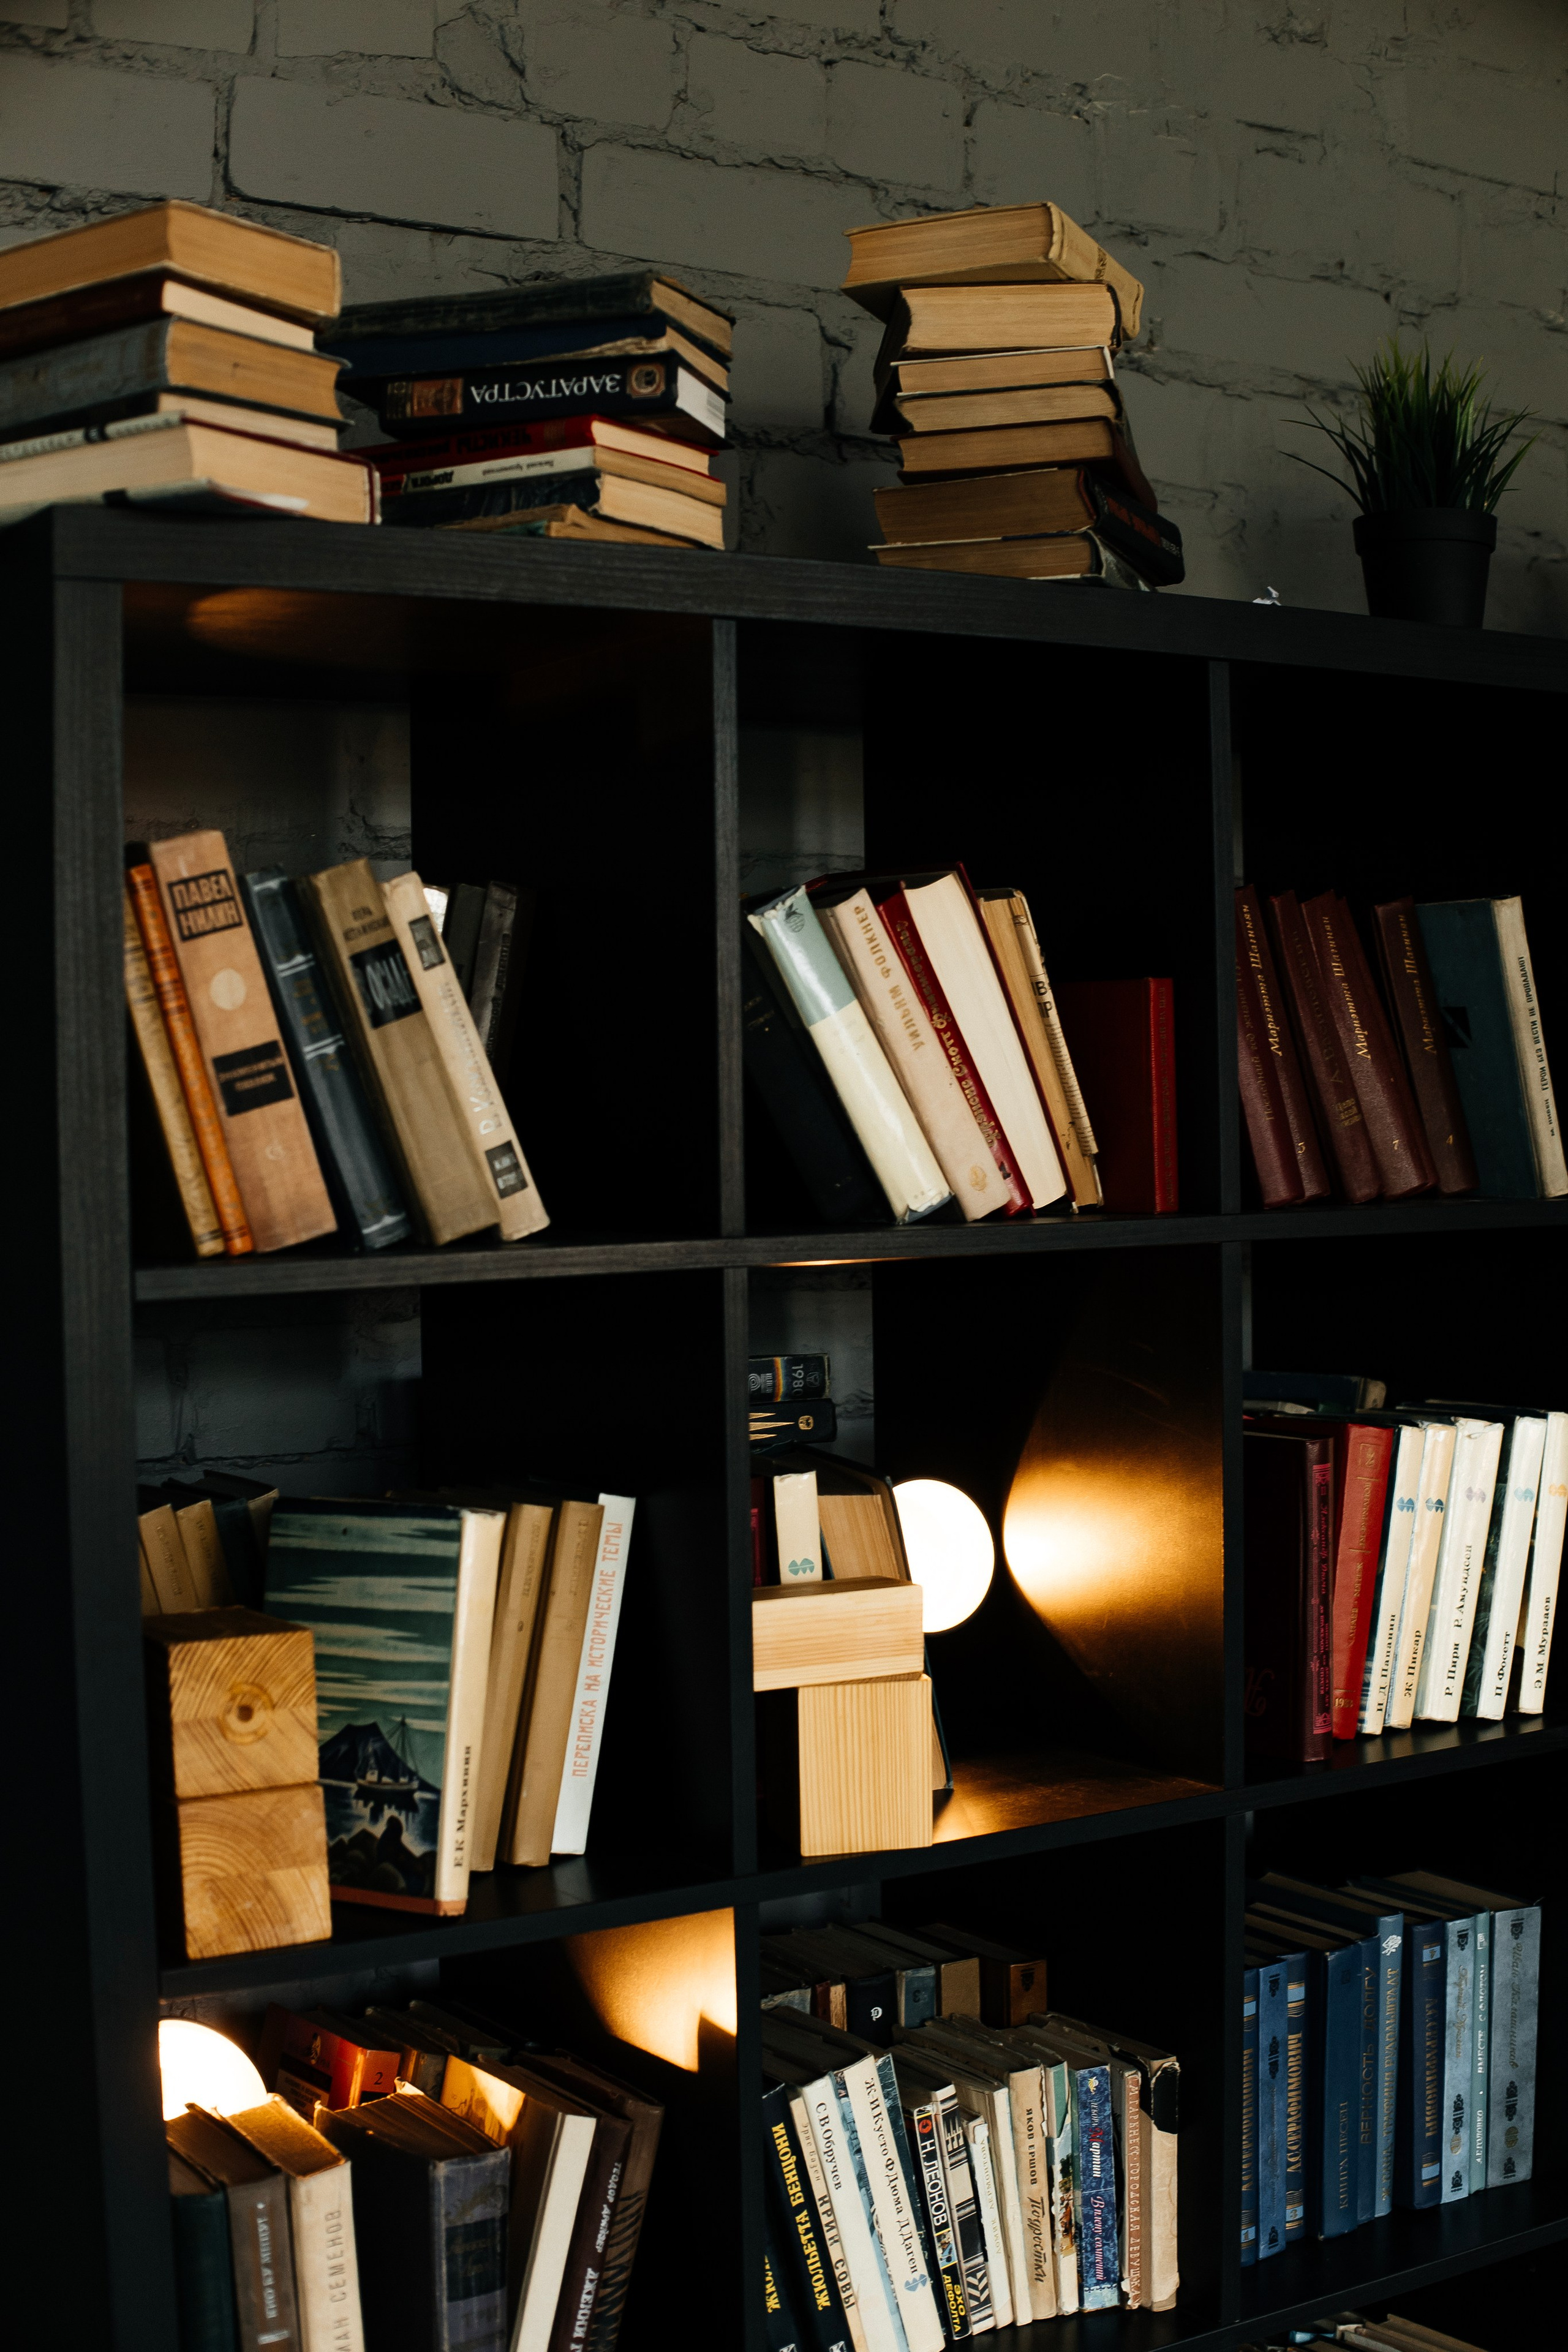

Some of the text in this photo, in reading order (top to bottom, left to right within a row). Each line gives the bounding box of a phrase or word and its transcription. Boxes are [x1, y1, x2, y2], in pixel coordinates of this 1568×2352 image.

[471, 374, 622, 404] ЗАРАТУСТРА
[174, 874, 232, 909] ПАВЕЛ
[178, 899, 238, 937] НИЛИН
[854, 906, 925, 1050] УИЛЬЯМ ФОЛКНЕР
[1242, 905, 1283, 1057] Мариэтта Шагинян
[1322, 917, 1371, 1061] Мариэтта Шагинян
[1398, 914, 1437, 1055] Мариэтта Шагинян
[1518, 956, 1534, 1003] ПРОПАДАЮТ
[1528, 1006, 1536, 1017] НЕ
[1530, 1020, 1542, 1045] ВЕСТИ
[941, 1031, 967, 1077] Скотт
[1536, 1048, 1545, 1063] БЕЗ
[1539, 1066, 1550, 1091] ГЕРОИ
[1297, 1142, 1306, 1154] 5
[1446, 1134, 1453, 1145] 4
[791, 1363, 804, 1396] 1980
[571, 1521, 623, 1777] ПЕРЕПИСКА НА ИСТОРИЧЕСКИЕ ТЕМЫ
[1381, 1614, 1396, 1678] Папанин
[1445, 1545, 1472, 1697] Р. Пири Р. Амундсен
[1538, 1596, 1551, 1657] Мурзаев
[1404, 1630, 1422, 1698] Ж. Пикар
[1498, 1631, 1510, 1681] Фосетт
[456, 1746, 472, 1831] Мархинин
[374, 2071, 383, 2085] 2
[1361, 1967, 1377, 2144] ВЕРНОСТЬ ДОЛГУ
[1383, 2071, 1395, 2136] ГРАФИНЯ
[809, 2151, 821, 2182] Базен
[979, 2139, 995, 2210] ЛЕРМОНТОВА
[1026, 2107, 1038, 2185] ЯКОВ ЕРШОВ
[1088, 2127, 1106, 2178] Мартин
[595, 2162, 622, 2253] ТЕОДОР ДРАЙЗЕР
[921, 2139, 948, 2227] Н. ЛЕОНОВ
[1129, 2162, 1140, 2232] ГОРОДСКАЯ
[1340, 2159, 1348, 2209] КНИГА
[772, 2122, 831, 2311] ЖЮЛЬЕТТА БЕНЦОНИ
[1027, 2196, 1047, 2283] Подростки
[1090, 2196, 1106, 2280] В плену сомнений
[325, 2210, 347, 2303] СЕМЕНОВ
[818, 2195, 856, 2310] КРИК СОВЫ
[1129, 2237, 1141, 2304] ДЕВУШКА
[573, 2267, 600, 2338] ДЖЕННИ
[943, 2274, 961, 2332] ДЕФОЛТА
[954, 2284, 966, 2317] ЭХО
